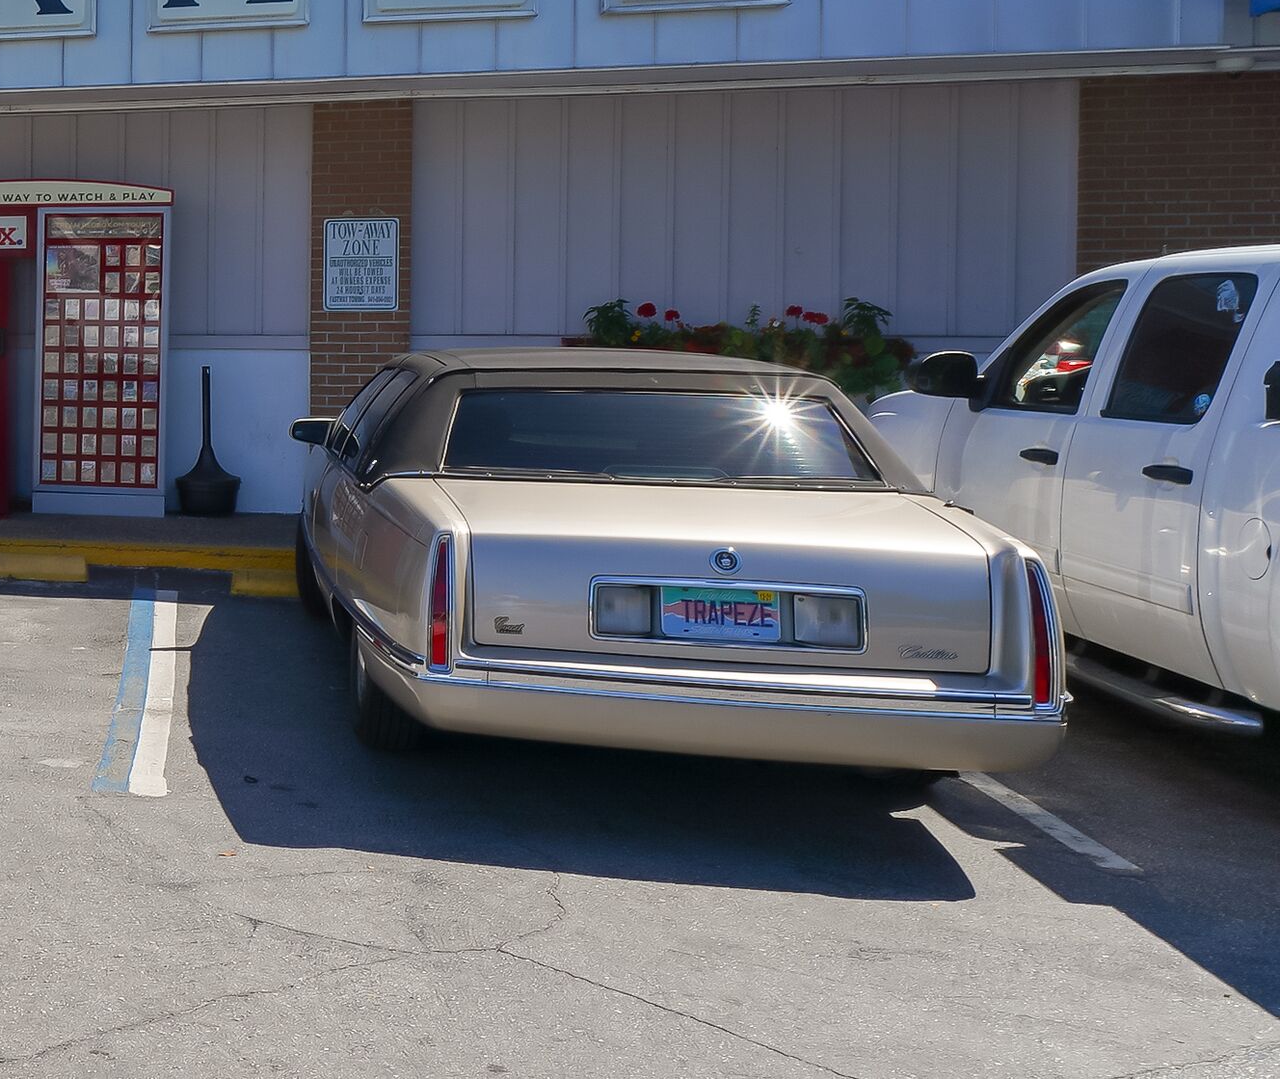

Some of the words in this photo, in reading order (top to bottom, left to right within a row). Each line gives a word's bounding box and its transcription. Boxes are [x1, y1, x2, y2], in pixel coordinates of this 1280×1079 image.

[2, 193, 31, 203] WAY
[35, 193, 52, 202] TO
[57, 192, 103, 202] WATCH
[109, 193, 116, 202] &
[122, 192, 156, 202] PLAY
[330, 222, 393, 239] TOW-AWAY
[342, 239, 380, 256] ZONE
[369, 258, 393, 267] VEHICLES
[339, 268, 352, 276] WILL
[354, 268, 362, 276] BE
[363, 267, 384, 276] TOWED
[331, 276, 338, 285] AT
[365, 276, 391, 285] EXPENSE
[336, 286, 343, 294] 24
[371, 286, 385, 294] DAYS
[680, 599, 774, 628] TRAPEZE
